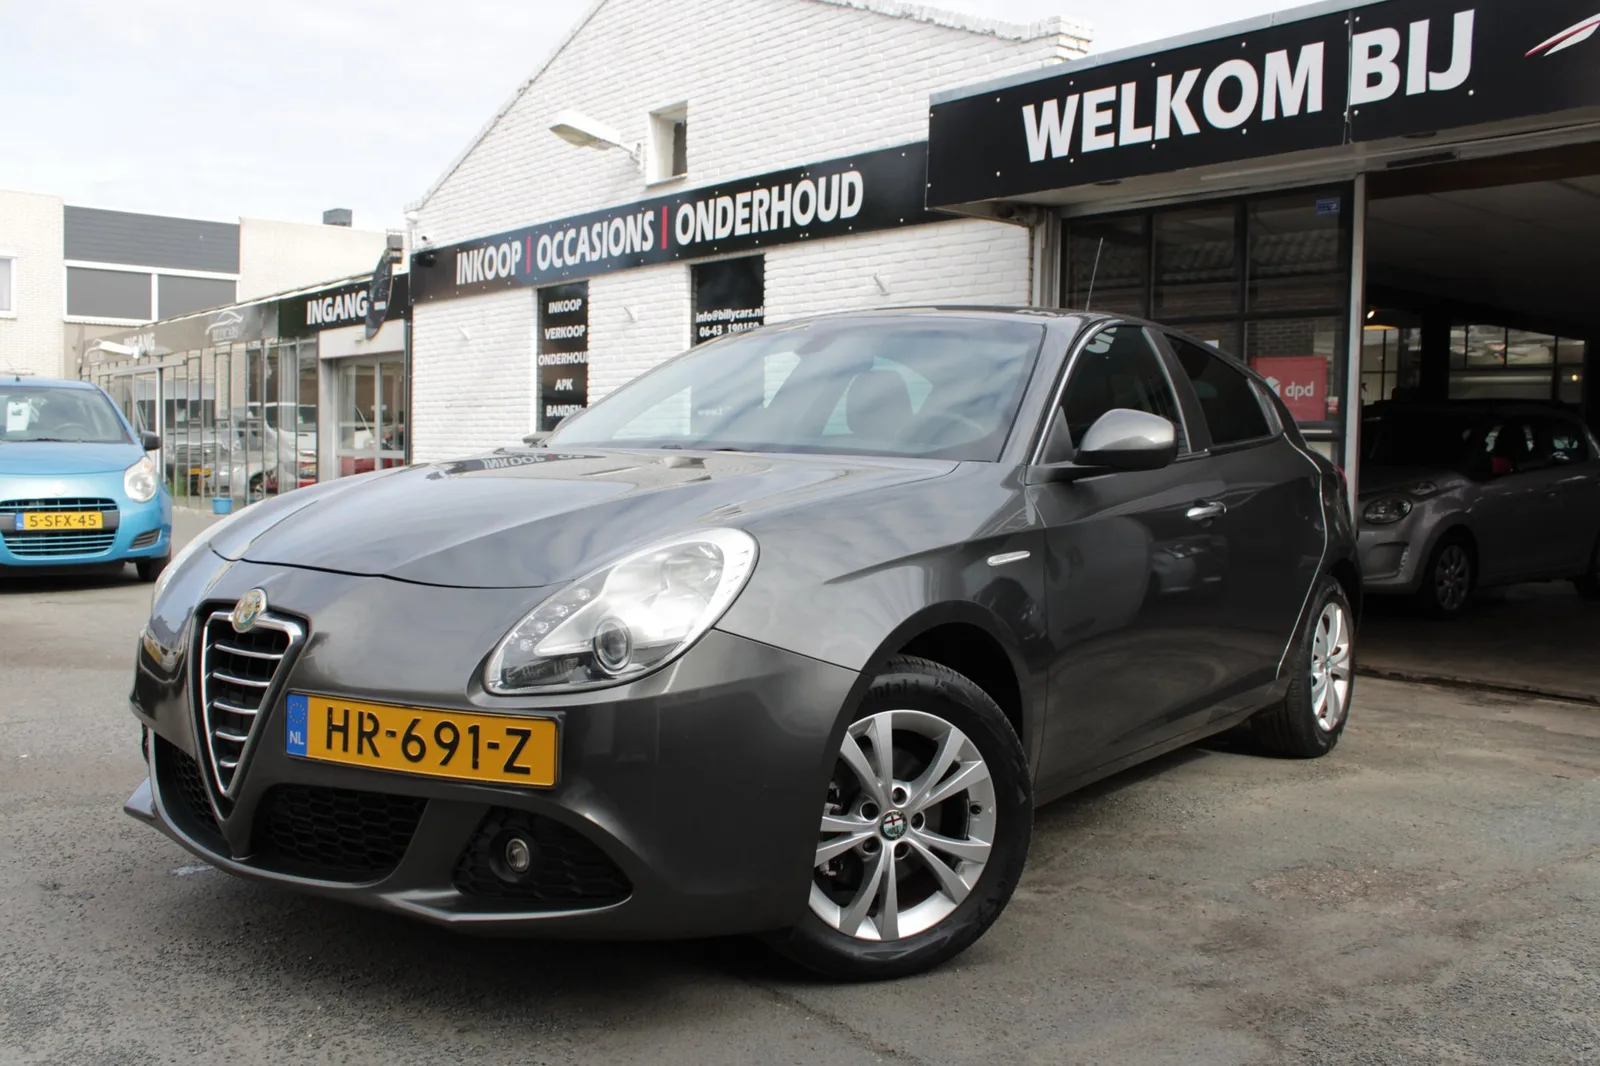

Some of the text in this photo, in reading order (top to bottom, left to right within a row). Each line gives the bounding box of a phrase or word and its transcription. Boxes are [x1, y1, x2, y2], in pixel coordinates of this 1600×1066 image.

[1021, 9, 1476, 163] WELKOM BIJ
[456, 170, 864, 285] INKOOP OCCASIONS ONDERHOUD
[306, 290, 368, 325] INGANG
[548, 298, 582, 314] INKOOP
[696, 306, 764, 322] info@billycars.nl
[544, 324, 586, 340] VERKOOP
[699, 325, 723, 338] 06-43
[554, 378, 573, 391] APK
[1285, 381, 1315, 401] dpd
[29, 514, 97, 528] 5-SFX-45
[289, 706, 532, 775] NL HR-691-Z
